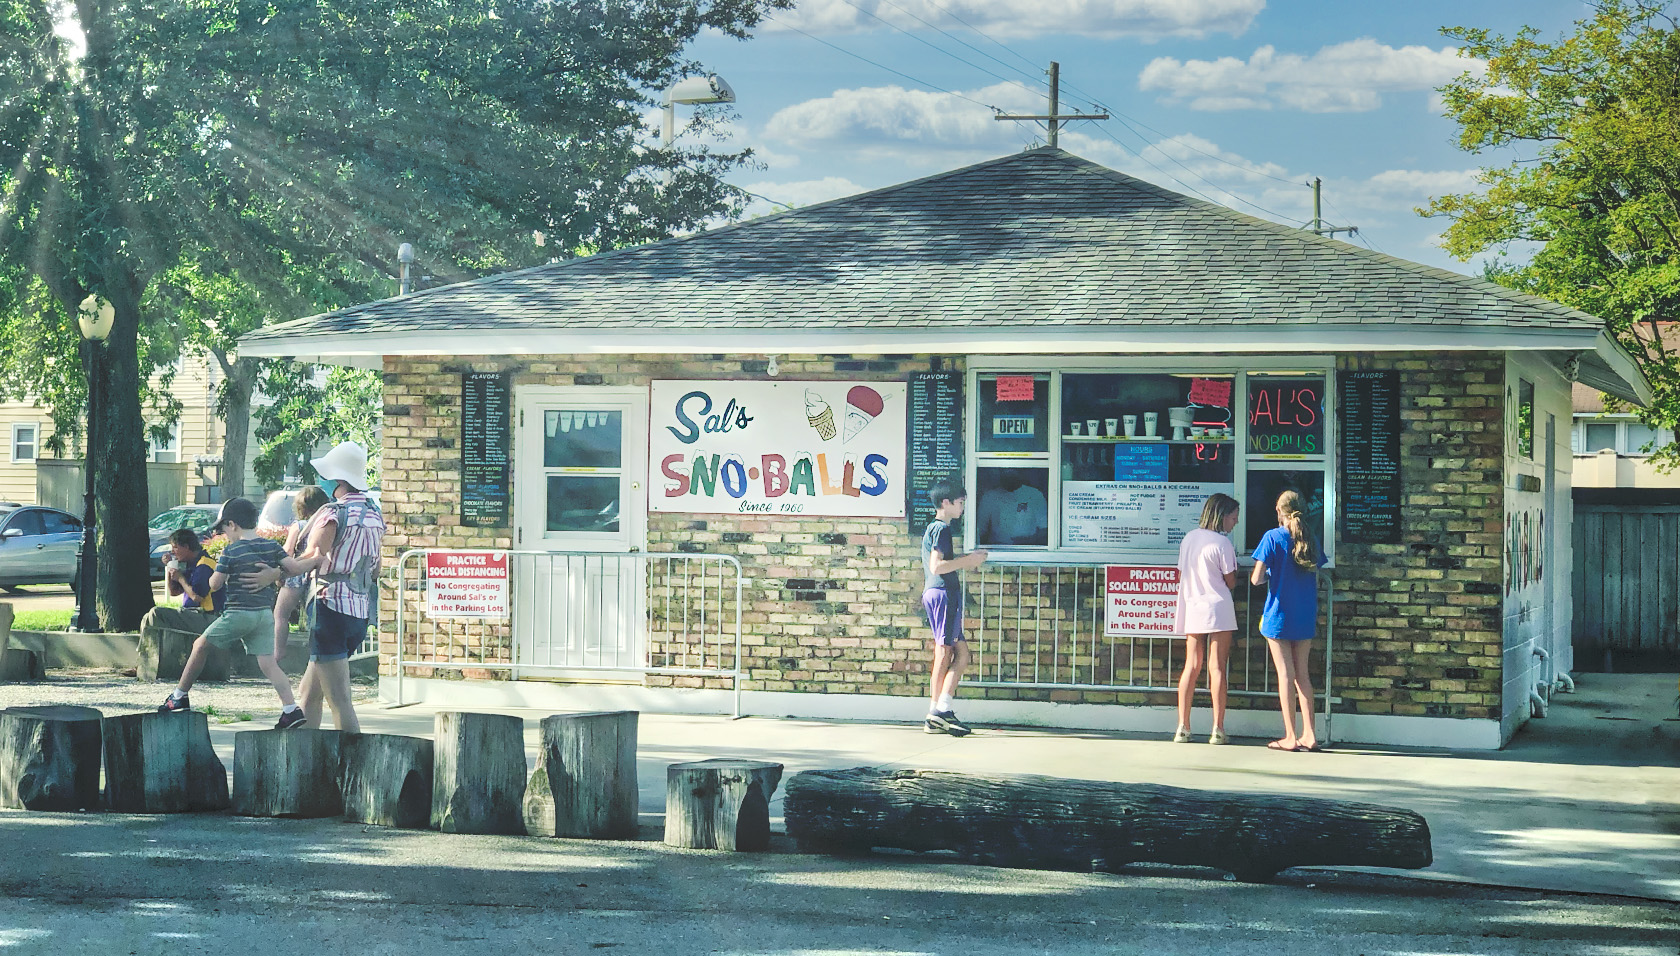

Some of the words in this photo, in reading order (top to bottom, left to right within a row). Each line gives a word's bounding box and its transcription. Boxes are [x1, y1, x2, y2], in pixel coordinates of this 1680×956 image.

[665, 390, 754, 444] Sal's
[999, 419, 1028, 434] OPEN
[738, 500, 773, 513] Since
[780, 502, 804, 513] 1960
[446, 555, 486, 565] PRACTICE
[429, 567, 457, 577] SOCIAL
[458, 567, 505, 577] DISTANCING
[1130, 570, 1176, 580] PRACTICE
[448, 582, 500, 592] Congregating
[1109, 581, 1140, 592] SOCIAL
[1143, 582, 1180, 592] DISTANC
[1130, 598, 1177, 608] Congregat
[455, 604, 485, 613] Parking
[1138, 622, 1174, 632] Parking
